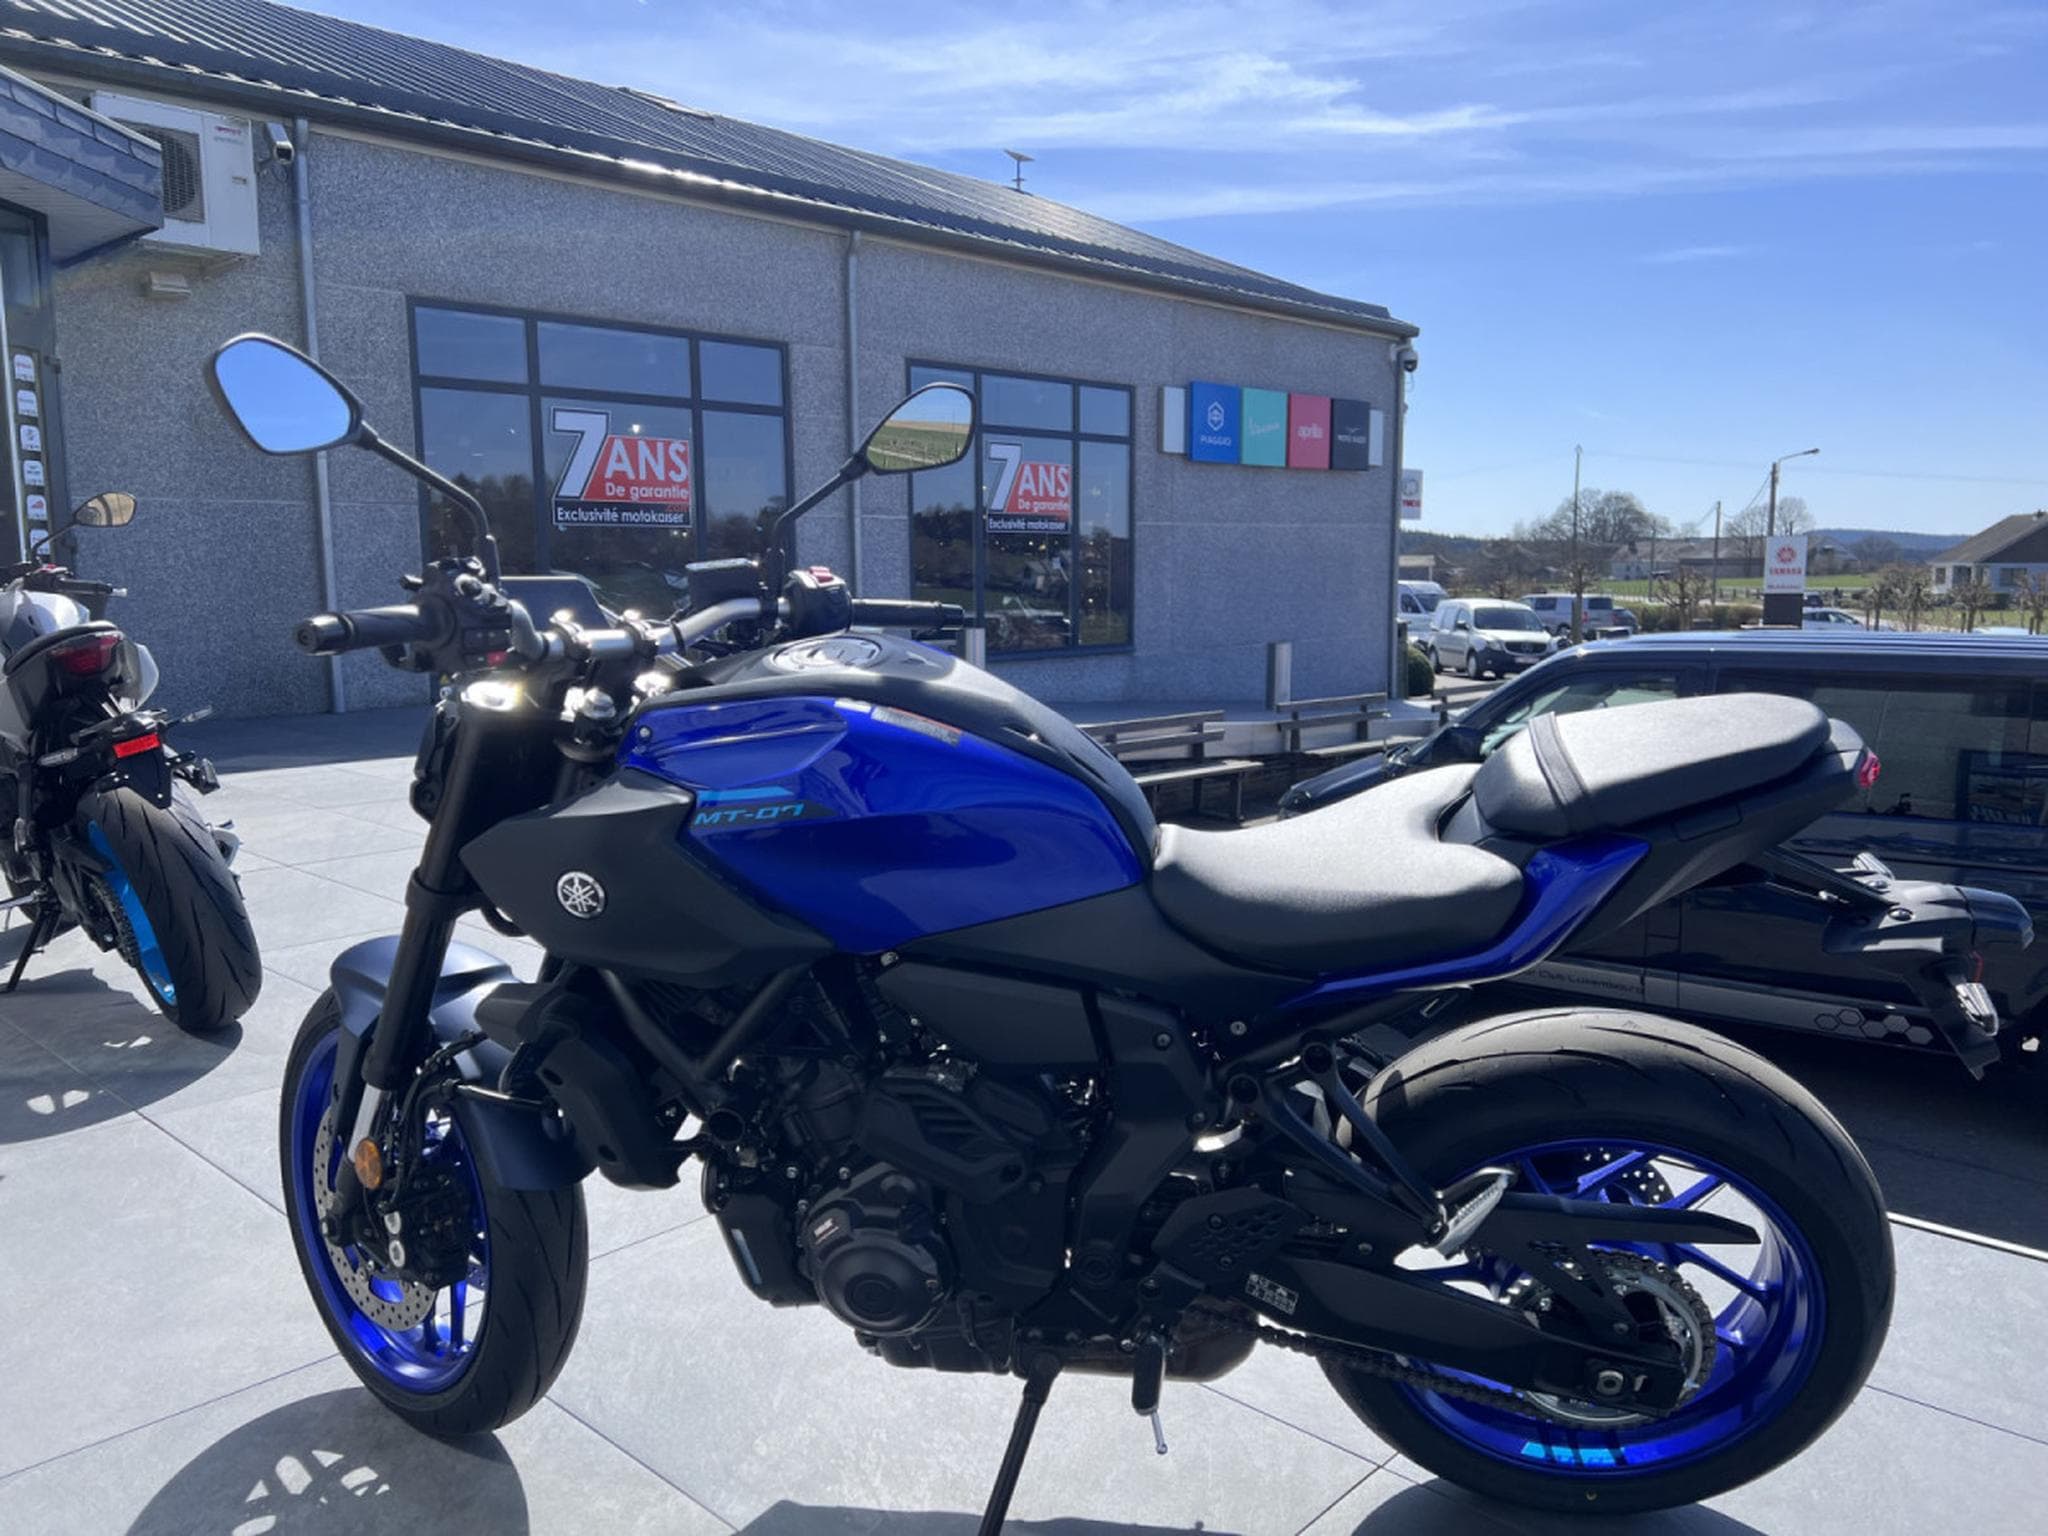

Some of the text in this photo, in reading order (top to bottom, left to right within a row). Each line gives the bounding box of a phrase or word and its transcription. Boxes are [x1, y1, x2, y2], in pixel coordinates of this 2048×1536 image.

[552, 408, 610, 499] 7
[1200, 434, 1232, 447] PIAGGIO
[604, 438, 689, 483] ANS
[988, 442, 1022, 512] 7
[1018, 463, 1070, 498] ANS
[605, 483, 690, 500] De garantie
[557, 507, 619, 523] Exclusivité
[694, 803, 804, 825] MT-07
